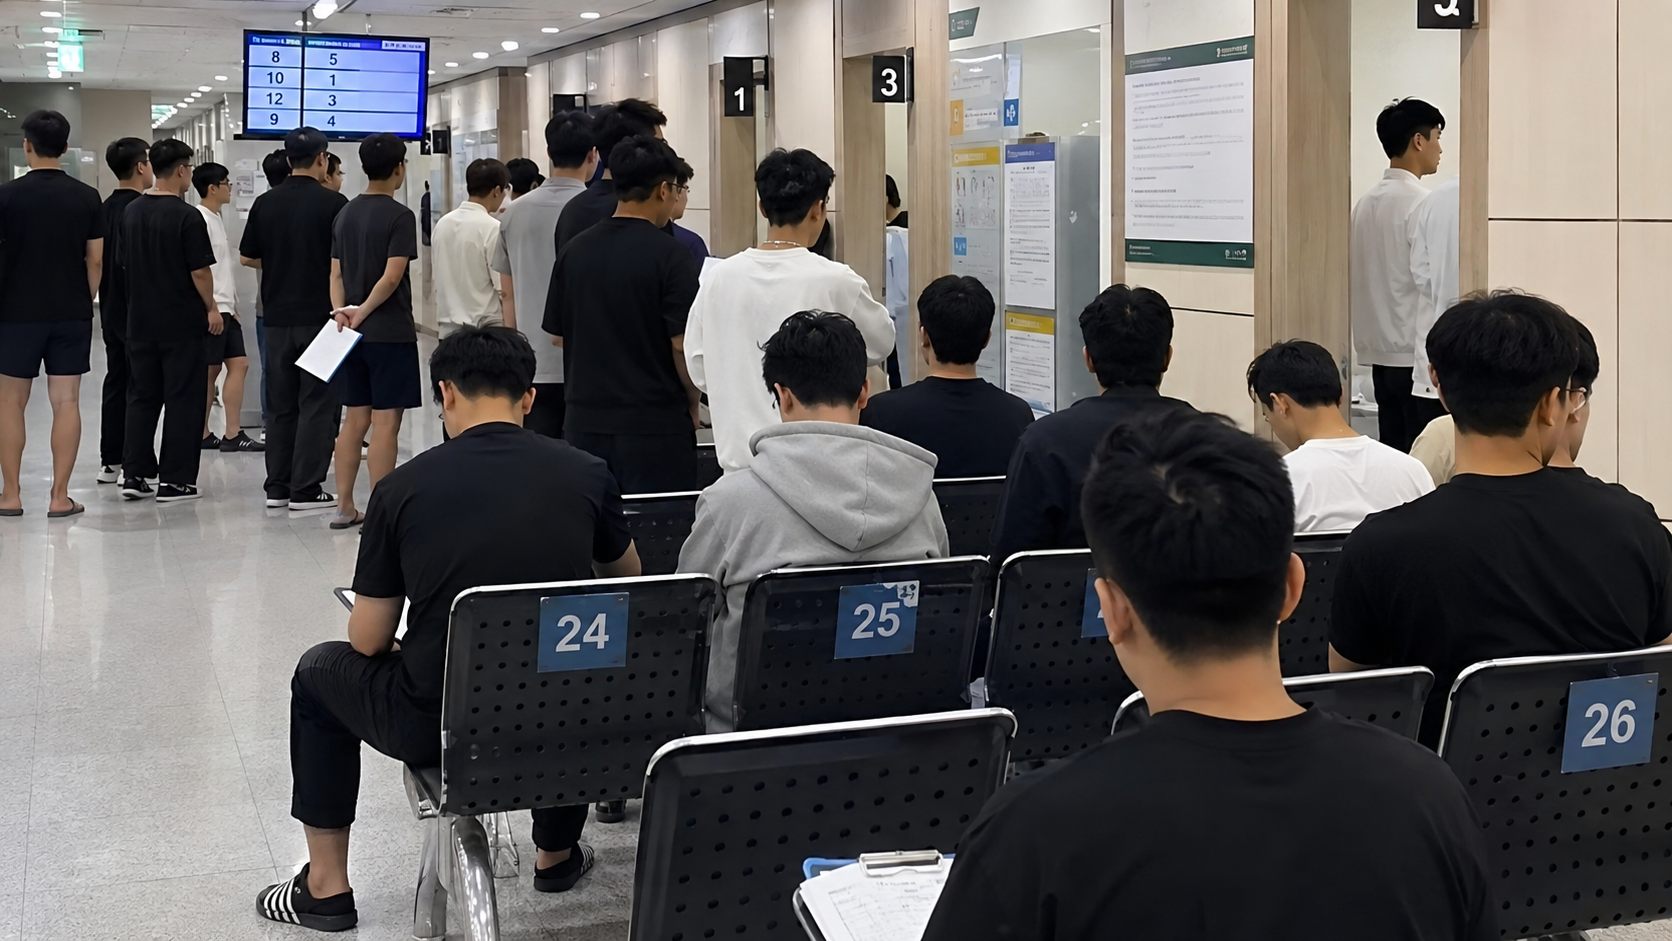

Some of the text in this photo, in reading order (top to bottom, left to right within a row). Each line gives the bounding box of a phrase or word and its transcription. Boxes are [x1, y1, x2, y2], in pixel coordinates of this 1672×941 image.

[271, 51, 280, 63] 8
[329, 53, 338, 65] 5
[266, 71, 284, 84] 10
[329, 74, 336, 86] 1
[880, 69, 898, 97] 3
[266, 92, 283, 105] 12
[328, 95, 337, 106] 3
[734, 86, 745, 112] 1
[270, 113, 279, 125] 9
[327, 115, 336, 127] 4
[851, 601, 900, 640] 25
[556, 613, 610, 653] 24
[1581, 699, 1636, 748] 26
